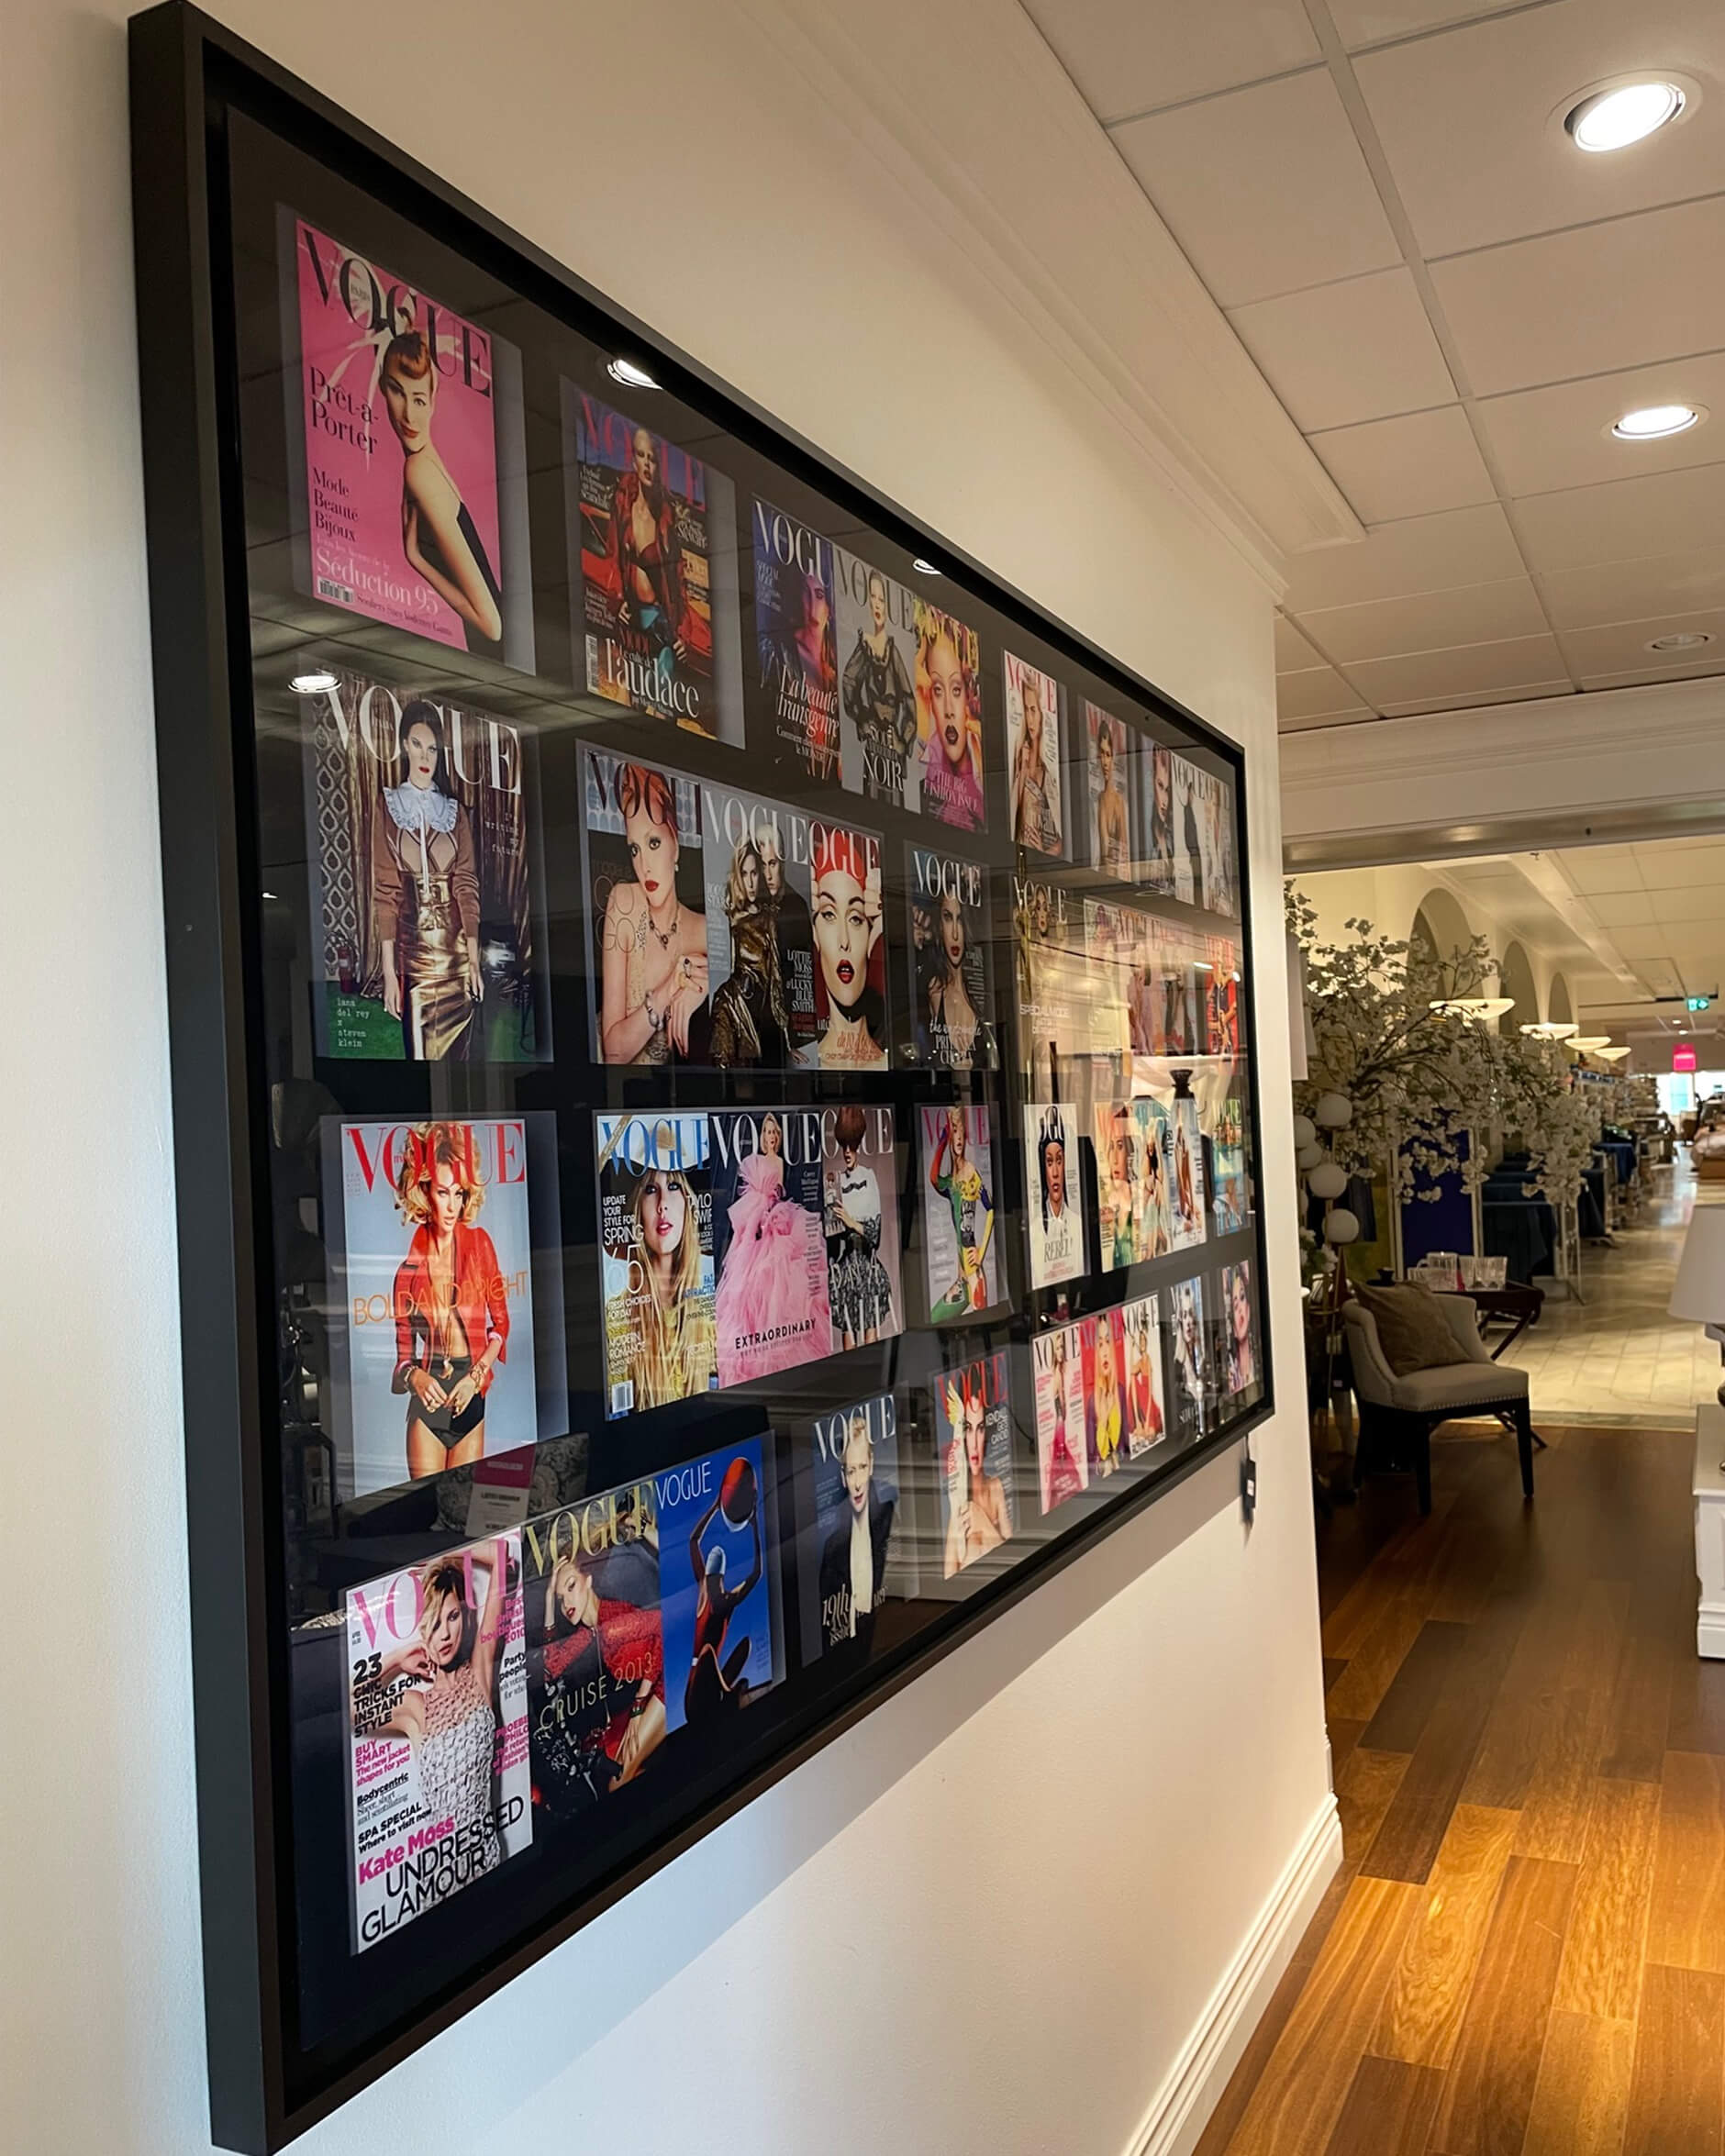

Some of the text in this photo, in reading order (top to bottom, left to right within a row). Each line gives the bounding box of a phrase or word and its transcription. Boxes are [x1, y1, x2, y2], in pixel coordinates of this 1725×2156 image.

[312, 395, 378, 455] Porter
[313, 466, 350, 499] Mode
[314, 488, 359, 522] Beauté
[315, 510, 356, 543] Bijoux
[755, 500, 834, 588] VOGU
[415, 584, 439, 617] 95
[836, 548, 915, 634] VOUE
[862, 747, 904, 793] NOIR
[808, 819, 882, 880] OGUE
[913, 850, 982, 908] VOGUE
[337, 996, 357, 1007] lana
[337, 1006, 371, 1020] del rey
[338, 1037, 363, 1049] klein
[709, 1112, 822, 1170] VOUE
[922, 1104, 991, 1147] VOUE
[602, 1195, 627, 1206] UPDATE
[603, 1205, 622, 1217] YOUR
[604, 1214, 636, 1228] STYLE FOR
[604, 1223, 645, 1247] SPRING
[353, 1291, 414, 1325] BOLD
[735, 1317, 817, 1350] EXTRAORDINARY
[1035, 1327, 1081, 1371] VOUE
[655, 1461, 712, 1511] VOGUE
[352, 1531, 523, 1651] VOUE
[353, 1651, 383, 1686] 23
[353, 1676, 383, 1699] CHIC
[353, 1673, 422, 1714] TRICKS FOR
[540, 1675, 607, 1730] CRUISE
[614, 1651, 653, 1693] 2013
[354, 1693, 405, 1727] INSTANT
[354, 1710, 393, 1739] STYLE
[355, 1739, 377, 1758] BUY
[355, 1741, 392, 1768] SMART
[356, 1744, 411, 1777] The new jacket
[356, 1754, 411, 1787] shapes for you
[356, 1773, 409, 1806] Bodycentric
[358, 1802, 422, 1844] SPA SPECIAL
[358, 1807, 432, 1853] Where to visit now
[359, 1816, 456, 1885] Kate Moss
[386, 1795, 525, 1898] UNDRESSED
[361, 1846, 486, 1942] GLAMOUR
